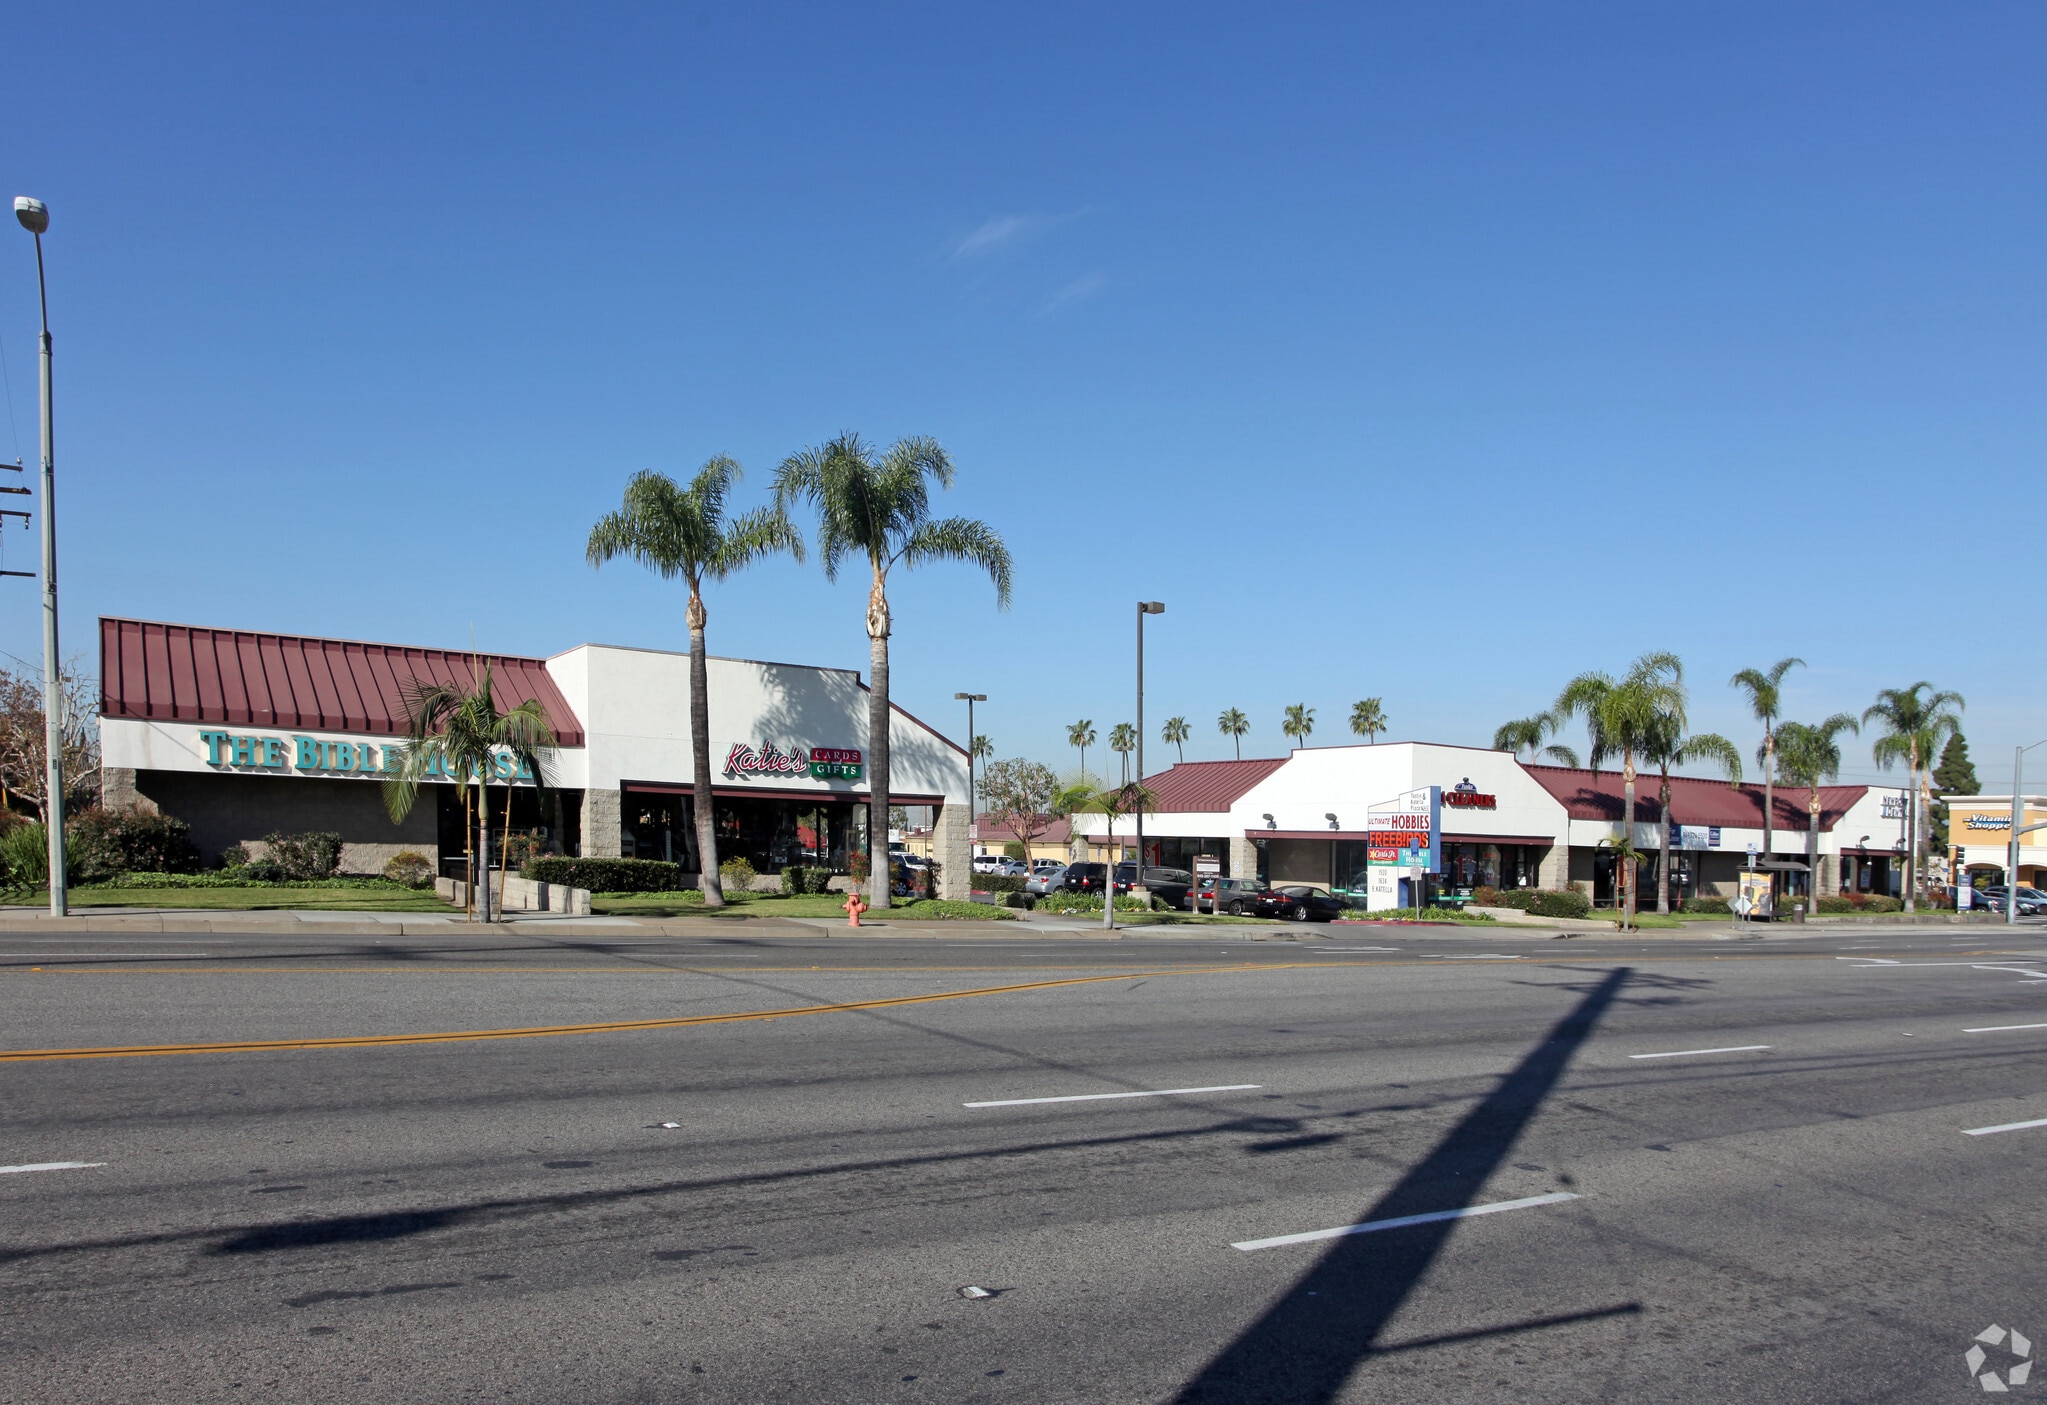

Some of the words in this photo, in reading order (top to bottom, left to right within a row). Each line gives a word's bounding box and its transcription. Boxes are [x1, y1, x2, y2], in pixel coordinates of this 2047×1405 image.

[200, 731, 283, 767] THE
[293, 735, 401, 773] BIBLE
[723, 740, 806, 774] Katie's
[815, 751, 858, 760] CARDS
[816, 765, 857, 774] GIFTS
[1446, 792, 1496, 807] CLEANERS
[1392, 815, 1430, 829] HOBBIES
[1968, 822, 2010, 830] Shoppe
